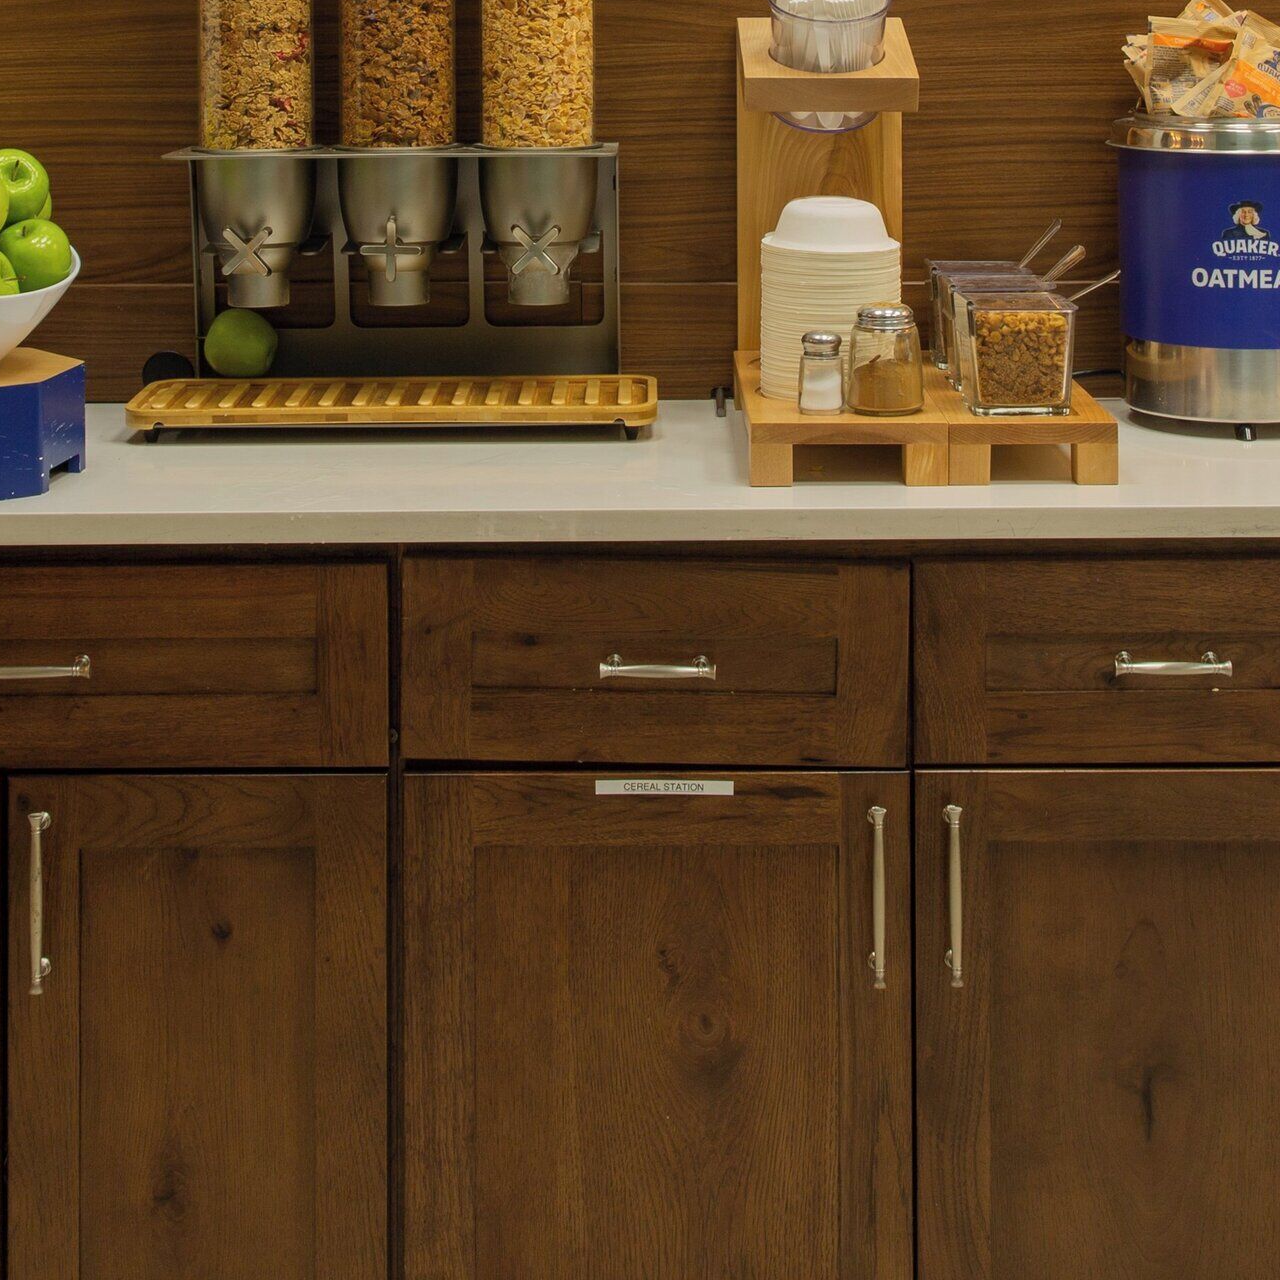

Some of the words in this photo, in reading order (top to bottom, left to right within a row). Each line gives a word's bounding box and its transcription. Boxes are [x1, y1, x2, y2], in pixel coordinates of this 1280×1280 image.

[1212, 239, 1280, 257] QUAKER
[623, 782, 661, 791] CEREAL
[663, 783, 704, 792] STATION
